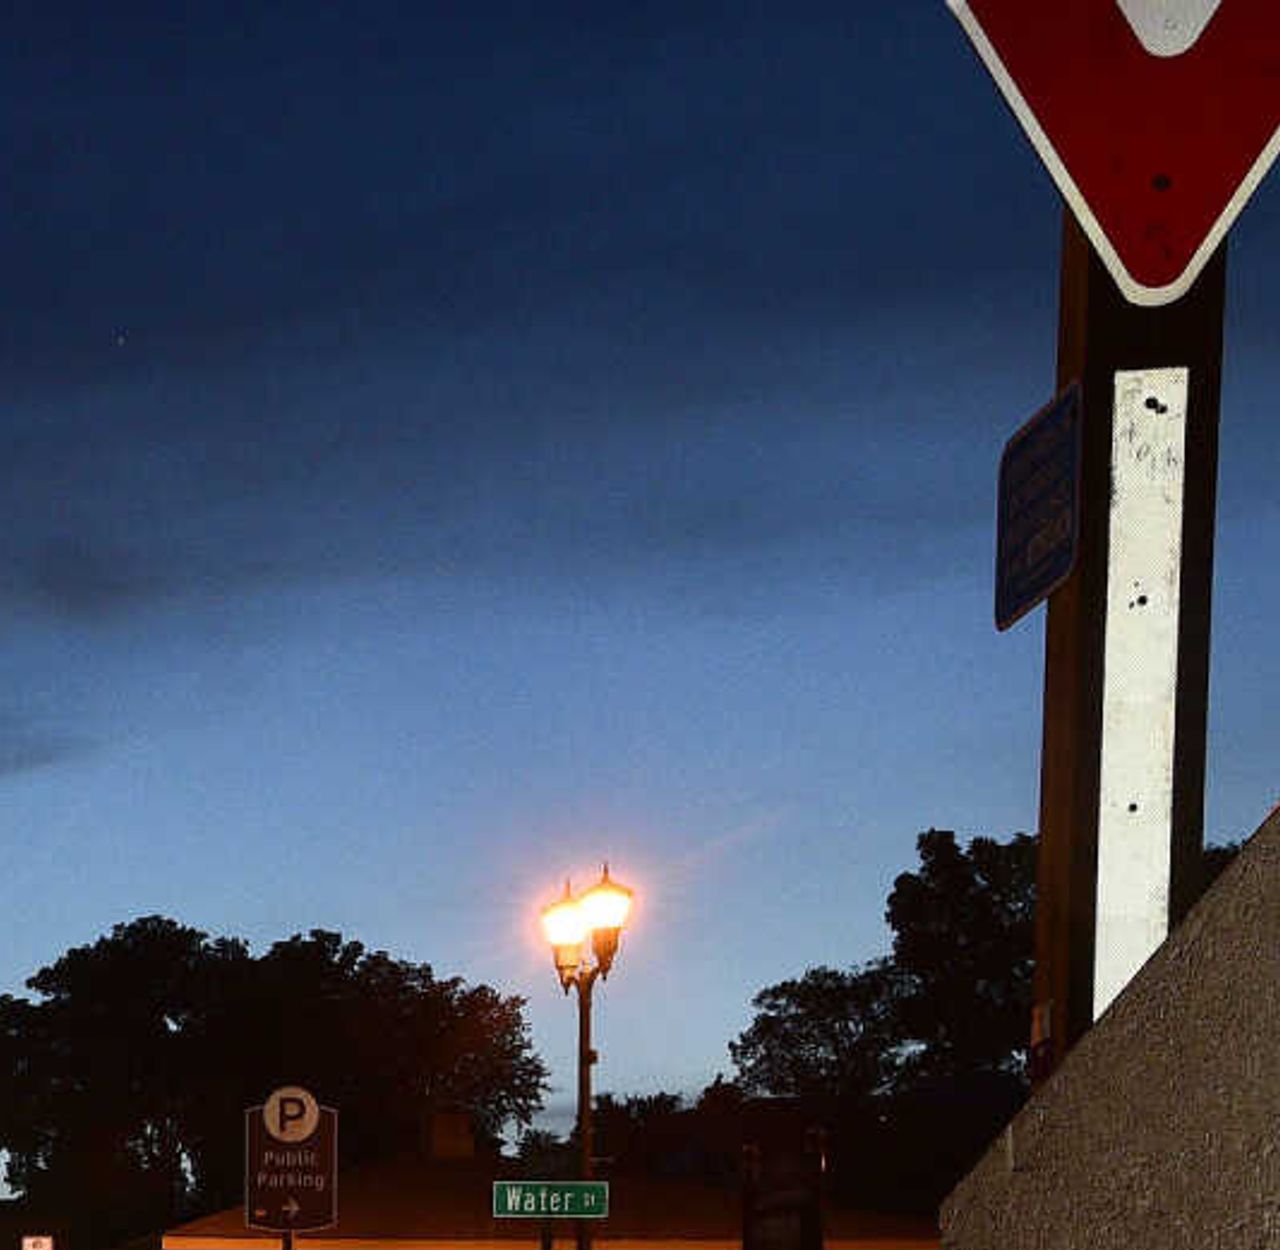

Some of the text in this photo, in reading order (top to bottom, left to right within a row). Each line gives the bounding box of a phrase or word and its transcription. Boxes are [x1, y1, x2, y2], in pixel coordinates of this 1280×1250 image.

[279, 1098, 306, 1133] P
[263, 1150, 321, 1168] Public
[256, 1172, 325, 1192] Parking
[505, 1186, 575, 1212] Water
